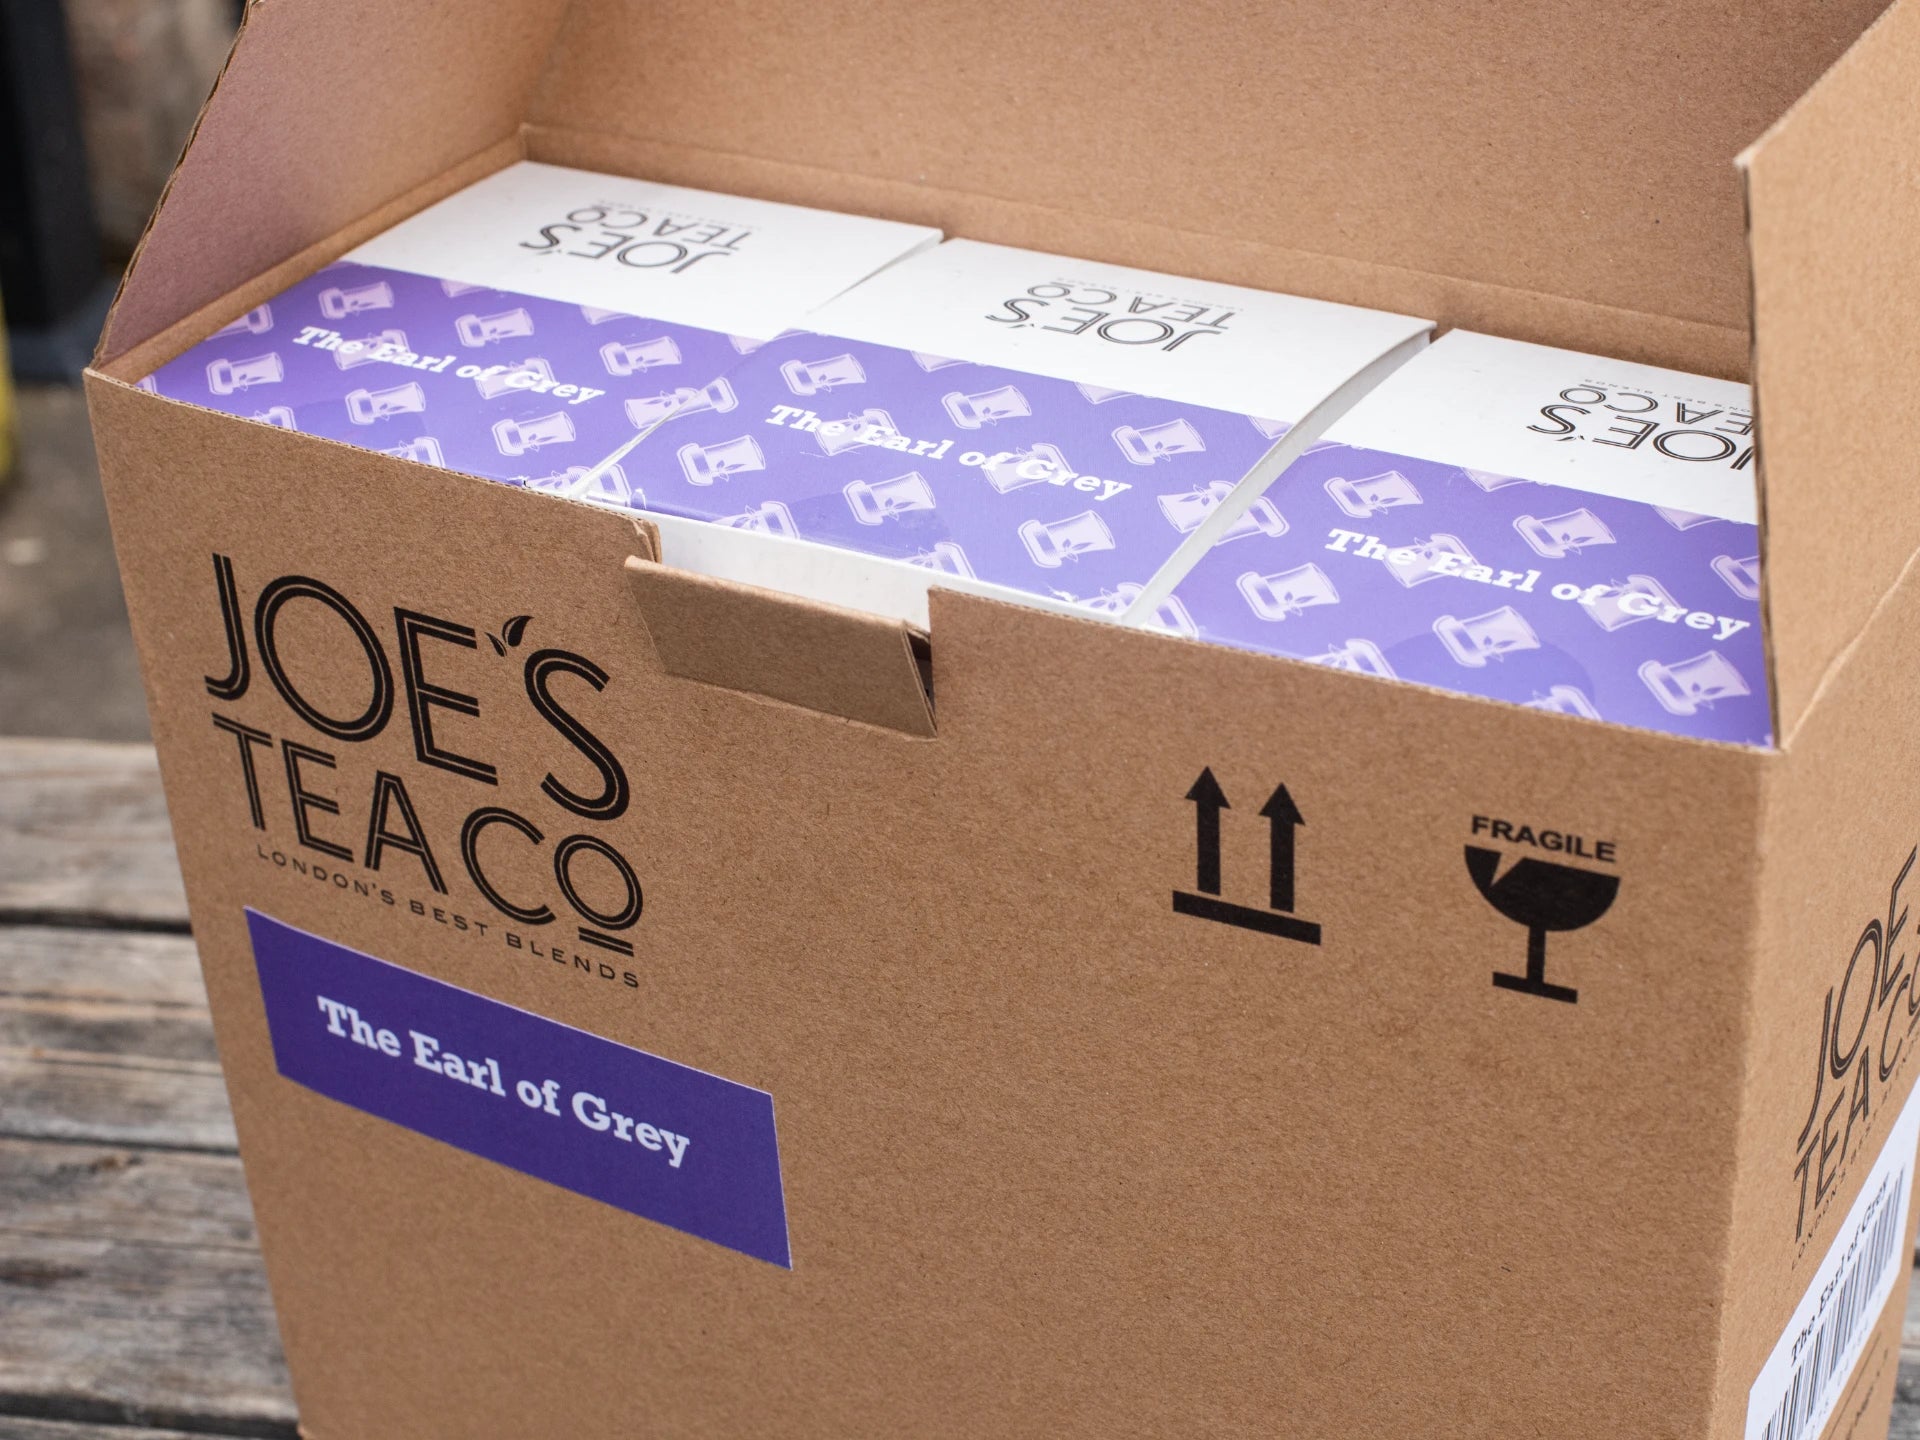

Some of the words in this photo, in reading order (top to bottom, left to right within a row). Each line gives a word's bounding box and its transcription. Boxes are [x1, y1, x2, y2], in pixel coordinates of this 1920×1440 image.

[519, 223, 731, 274] JOE'S
[293, 326, 364, 353] The
[367, 342, 456, 373] Earl
[455, 363, 508, 381] of
[504, 370, 606, 405] Grey
[985, 298, 1222, 352] JOE'S
[765, 404, 845, 436] The
[853, 424, 954, 459] Earl
[958, 449, 1016, 471] of
[1015, 459, 1132, 501] Grey
[1676, 401, 1754, 436] EA
[1324, 528, 1415, 566] The
[1428, 550, 1542, 593] Earl
[1551, 582, 1612, 606] of
[1616, 591, 1750, 641] Grey
[204, 552, 630, 821] JOE'S
[1471, 814, 1617, 863] FRAGILE
[256, 842, 396, 906] LONDON'S
[409, 899, 489, 937] BEST
[505, 931, 640, 989] BLENDS
[1797, 843, 1920, 1153] JOE
[317, 995, 401, 1057] The
[408, 1030, 506, 1097] Earl
[515, 1079, 561, 1117] of
[571, 1091, 690, 1169] Grey
[1791, 1315, 1815, 1367] The
[1818, 1254, 1845, 1317] Earl
[1847, 1223, 1861, 1262] of
[1862, 1172, 1890, 1233] Grey
